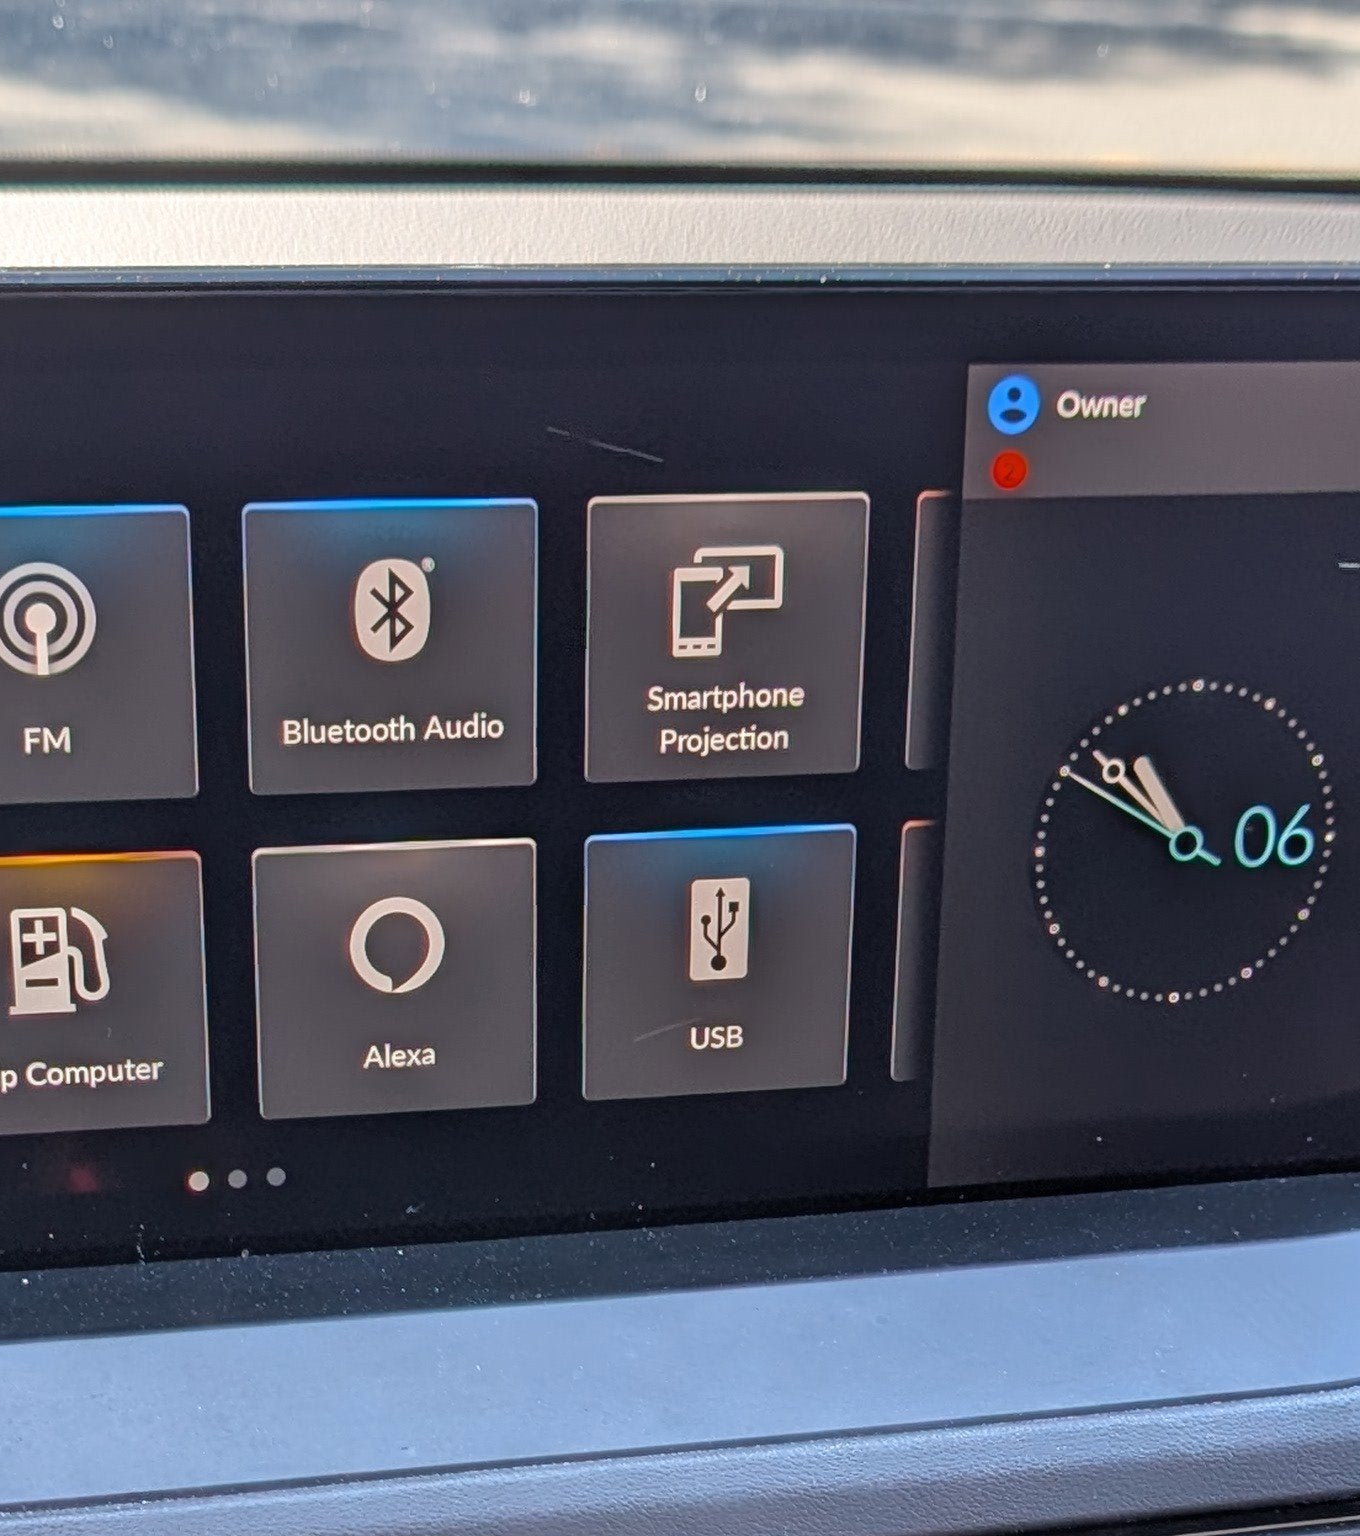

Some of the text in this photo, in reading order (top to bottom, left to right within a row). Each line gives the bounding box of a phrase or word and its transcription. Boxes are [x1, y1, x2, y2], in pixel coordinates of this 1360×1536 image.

[1056, 389, 1147, 420] Owner
[647, 682, 805, 713] Smartphone
[24, 727, 71, 754] FM
[282, 712, 505, 745] Bluetooth Audio
[660, 723, 790, 756] Projection
[1235, 803, 1314, 868] 06
[690, 1025, 744, 1051] USB
[362, 1043, 436, 1069] Alexa
[26, 1058, 164, 1091] Computer
